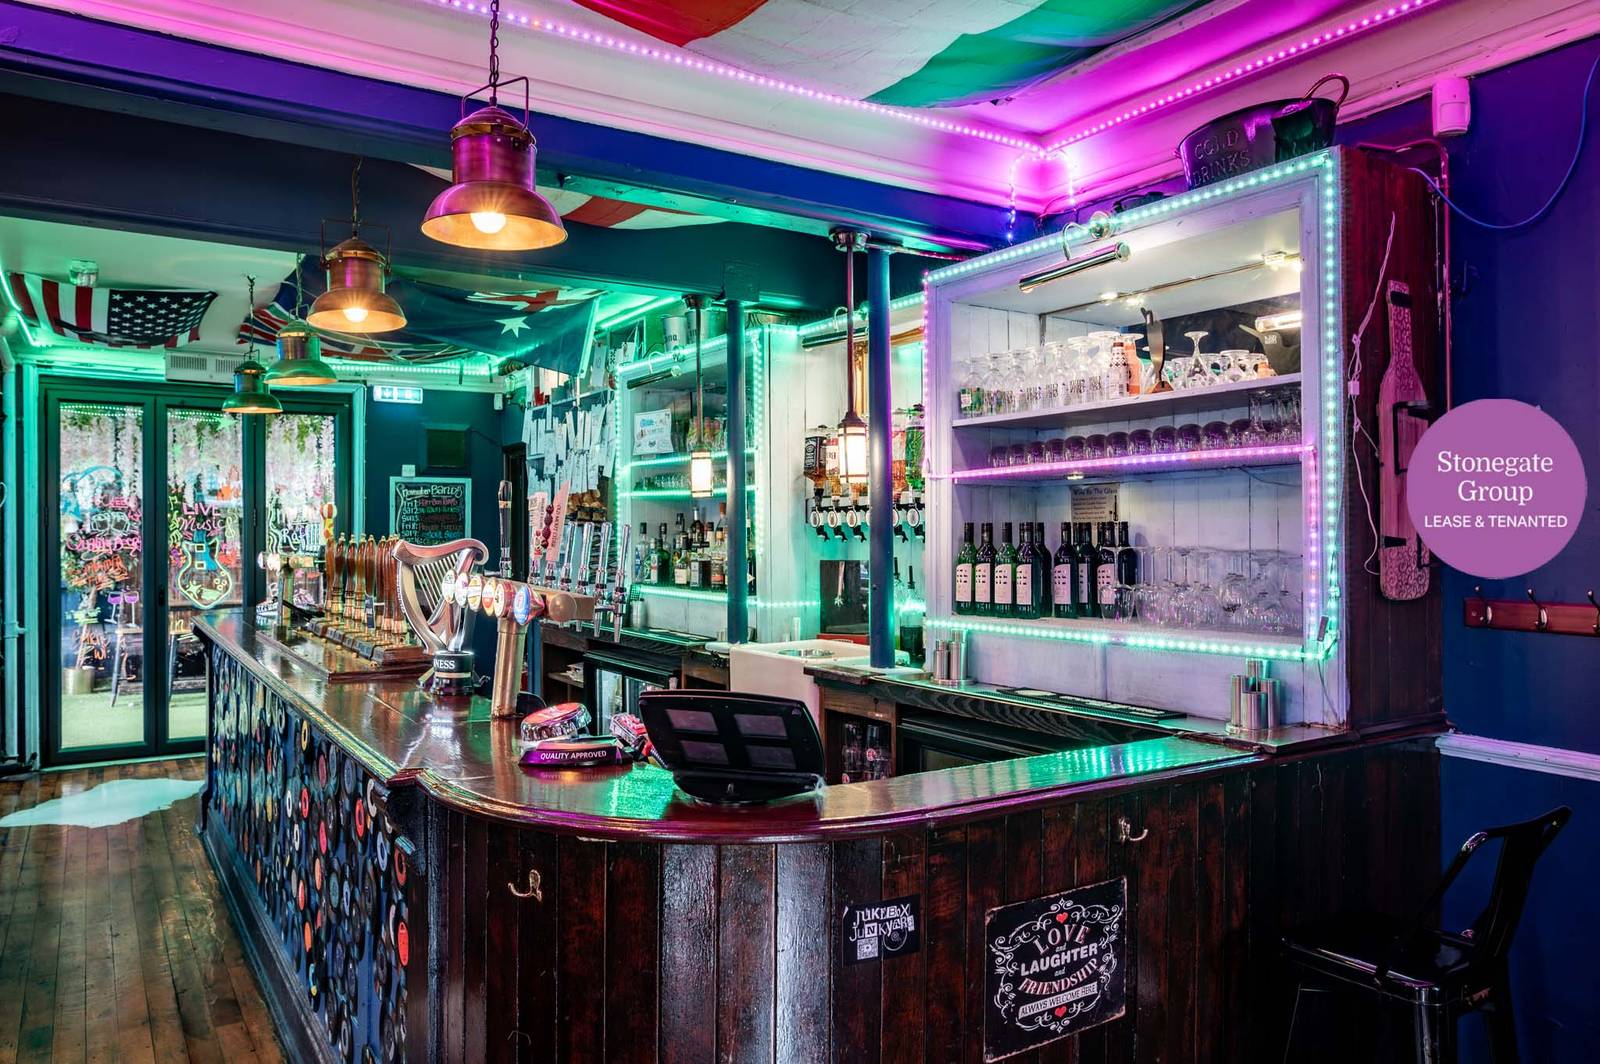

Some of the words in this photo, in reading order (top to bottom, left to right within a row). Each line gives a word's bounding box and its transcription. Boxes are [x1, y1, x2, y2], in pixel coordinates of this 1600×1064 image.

[1193, 150, 1251, 186] DRINKS
[178, 516, 226, 531] Music
[182, 502, 221, 516] LIVE
[540, 751, 569, 760] QUALITY
[570, 750, 607, 759] APPROVED
[1033, 924, 1089, 955] LOVE
[1021, 943, 1098, 976] LAUGHTER
[1018, 958, 1098, 995] FRIENDSHIP
[1020, 1000, 1048, 1016] ALWAYS
[1048, 991, 1080, 1008] WELCOME
[1081, 984, 1096, 996] HERE
